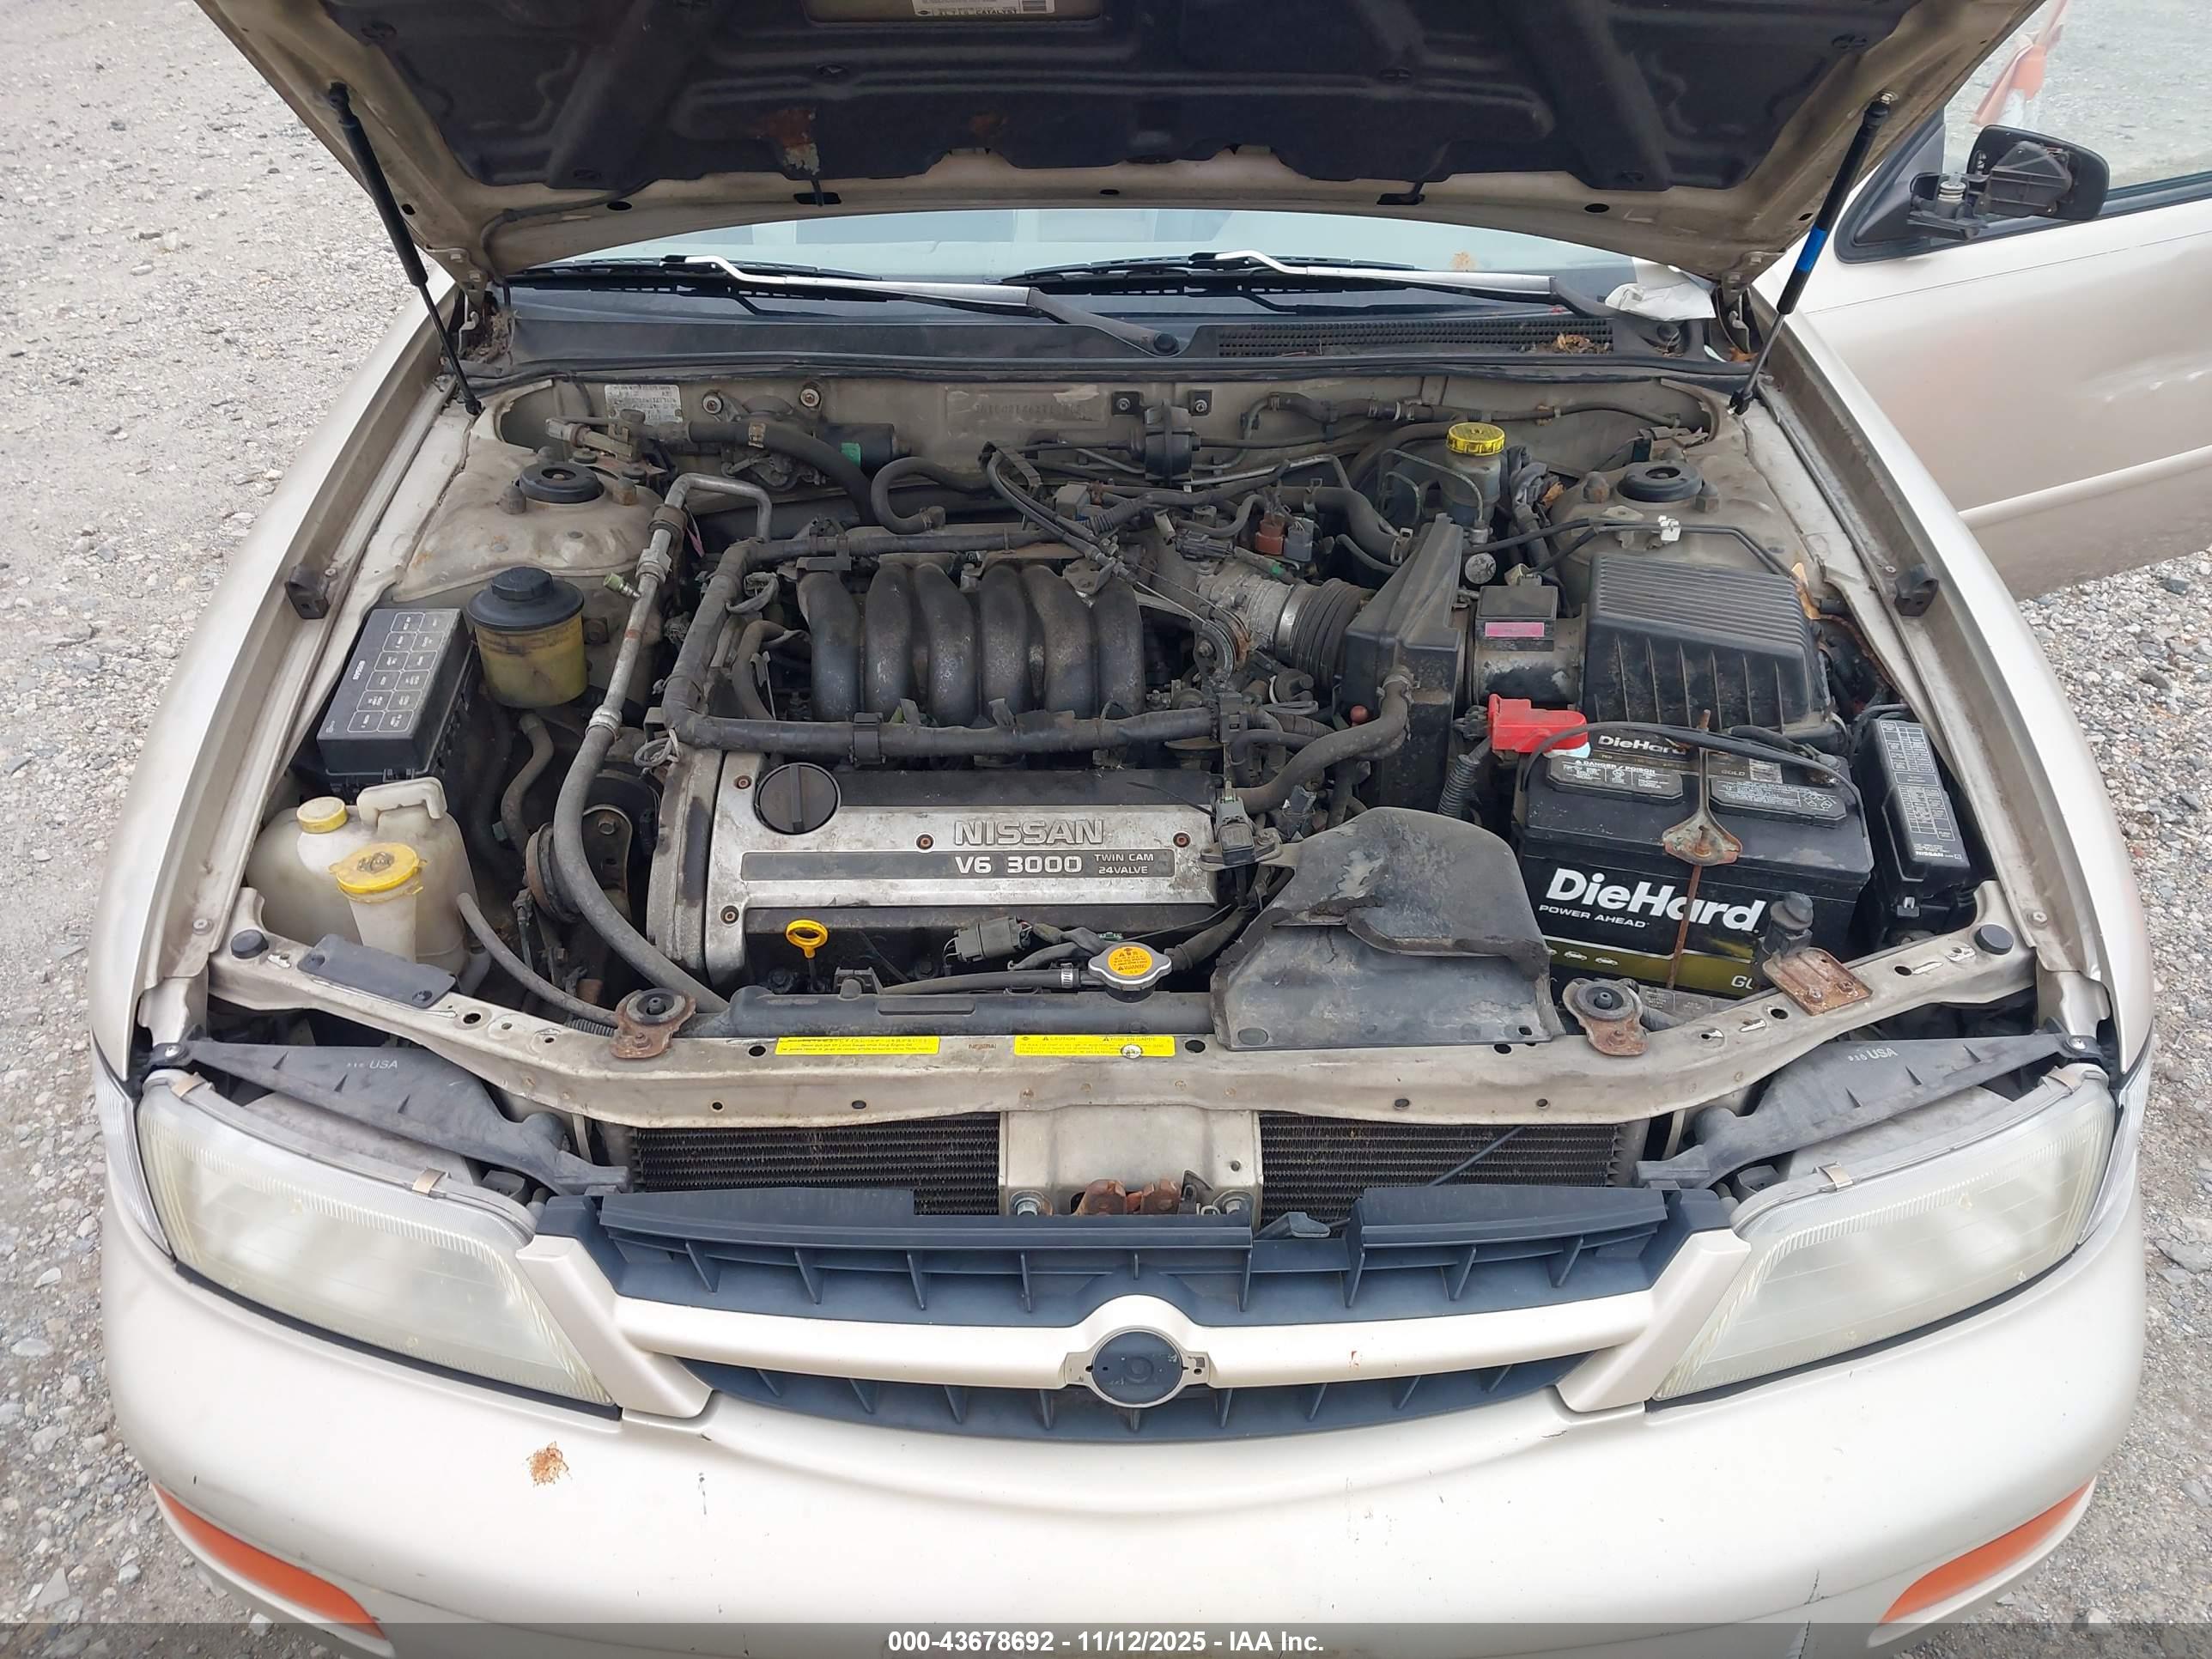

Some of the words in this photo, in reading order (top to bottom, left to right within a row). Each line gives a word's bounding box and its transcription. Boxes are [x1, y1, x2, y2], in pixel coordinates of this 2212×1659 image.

[953, 817, 1104, 846] NISSAN
[955, 855, 992, 874] V6
[1007, 854, 1082, 874] 3000
[1094, 853, 1125, 862] TWIN
[1128, 853, 1154, 862] CAM
[1098, 866, 1148, 875] 24VALVE
[1546, 867, 1766, 932] DieHard
[1538, 904, 1590, 921] POWER
[1595, 914, 1646, 928] AHEAD
[1866, 1048, 1899, 1060] USA
[369, 1060, 398, 1070] USA
